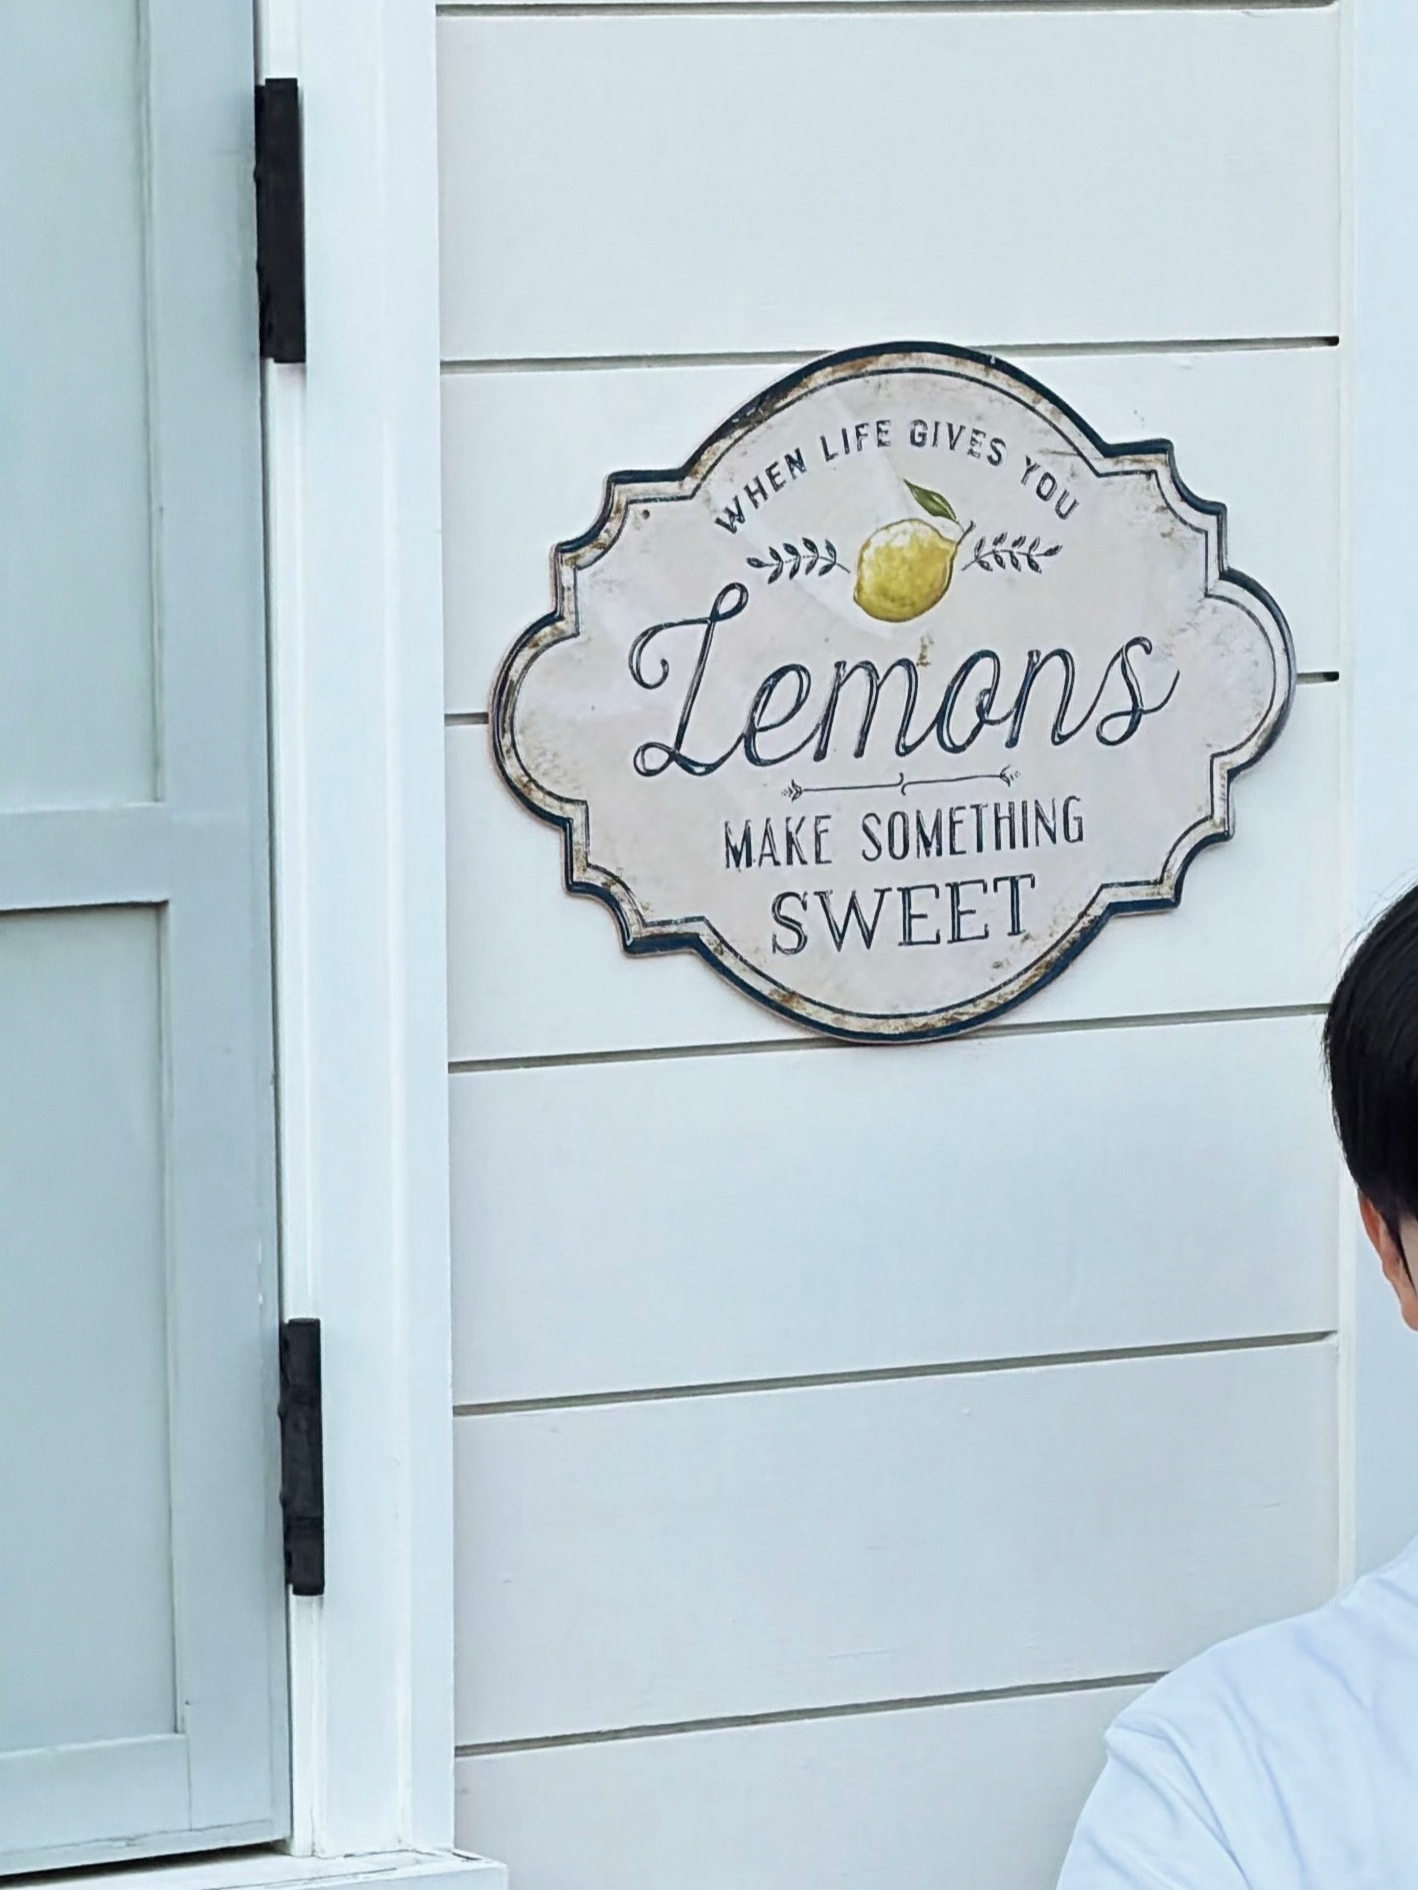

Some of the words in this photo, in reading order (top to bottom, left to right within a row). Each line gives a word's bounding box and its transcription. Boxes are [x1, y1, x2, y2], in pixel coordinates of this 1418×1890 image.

[713, 447, 808, 534] WHEN
[819, 419, 891, 462] LIFE
[909, 418, 1007, 467] GIVES
[1021, 455, 1080, 521] YOU
[628, 582, 1180, 777] Lemons
[724, 814, 833, 870] MAKE
[861, 795, 1084, 861] SOMETHING
[771, 873, 1036, 956] SWEET
